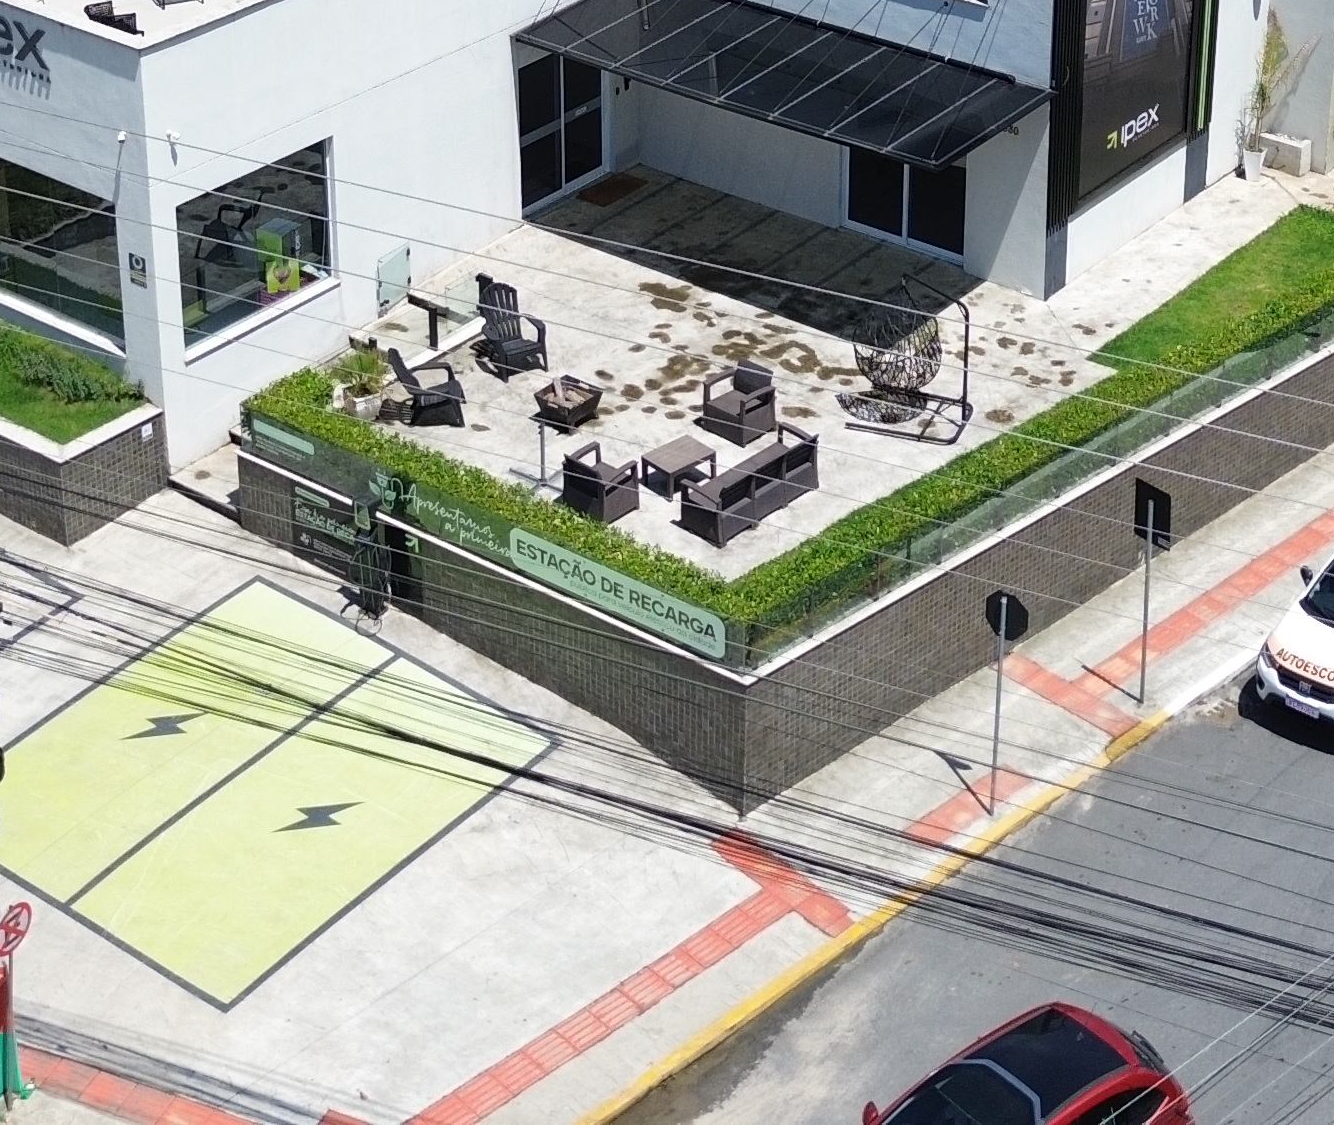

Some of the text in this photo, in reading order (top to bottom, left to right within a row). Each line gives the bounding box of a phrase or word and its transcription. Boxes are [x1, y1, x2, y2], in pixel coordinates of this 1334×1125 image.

[399, 483, 495, 539] Apresentamos
[516, 538, 717, 641] ESTAÇÃO DE RECARGA
